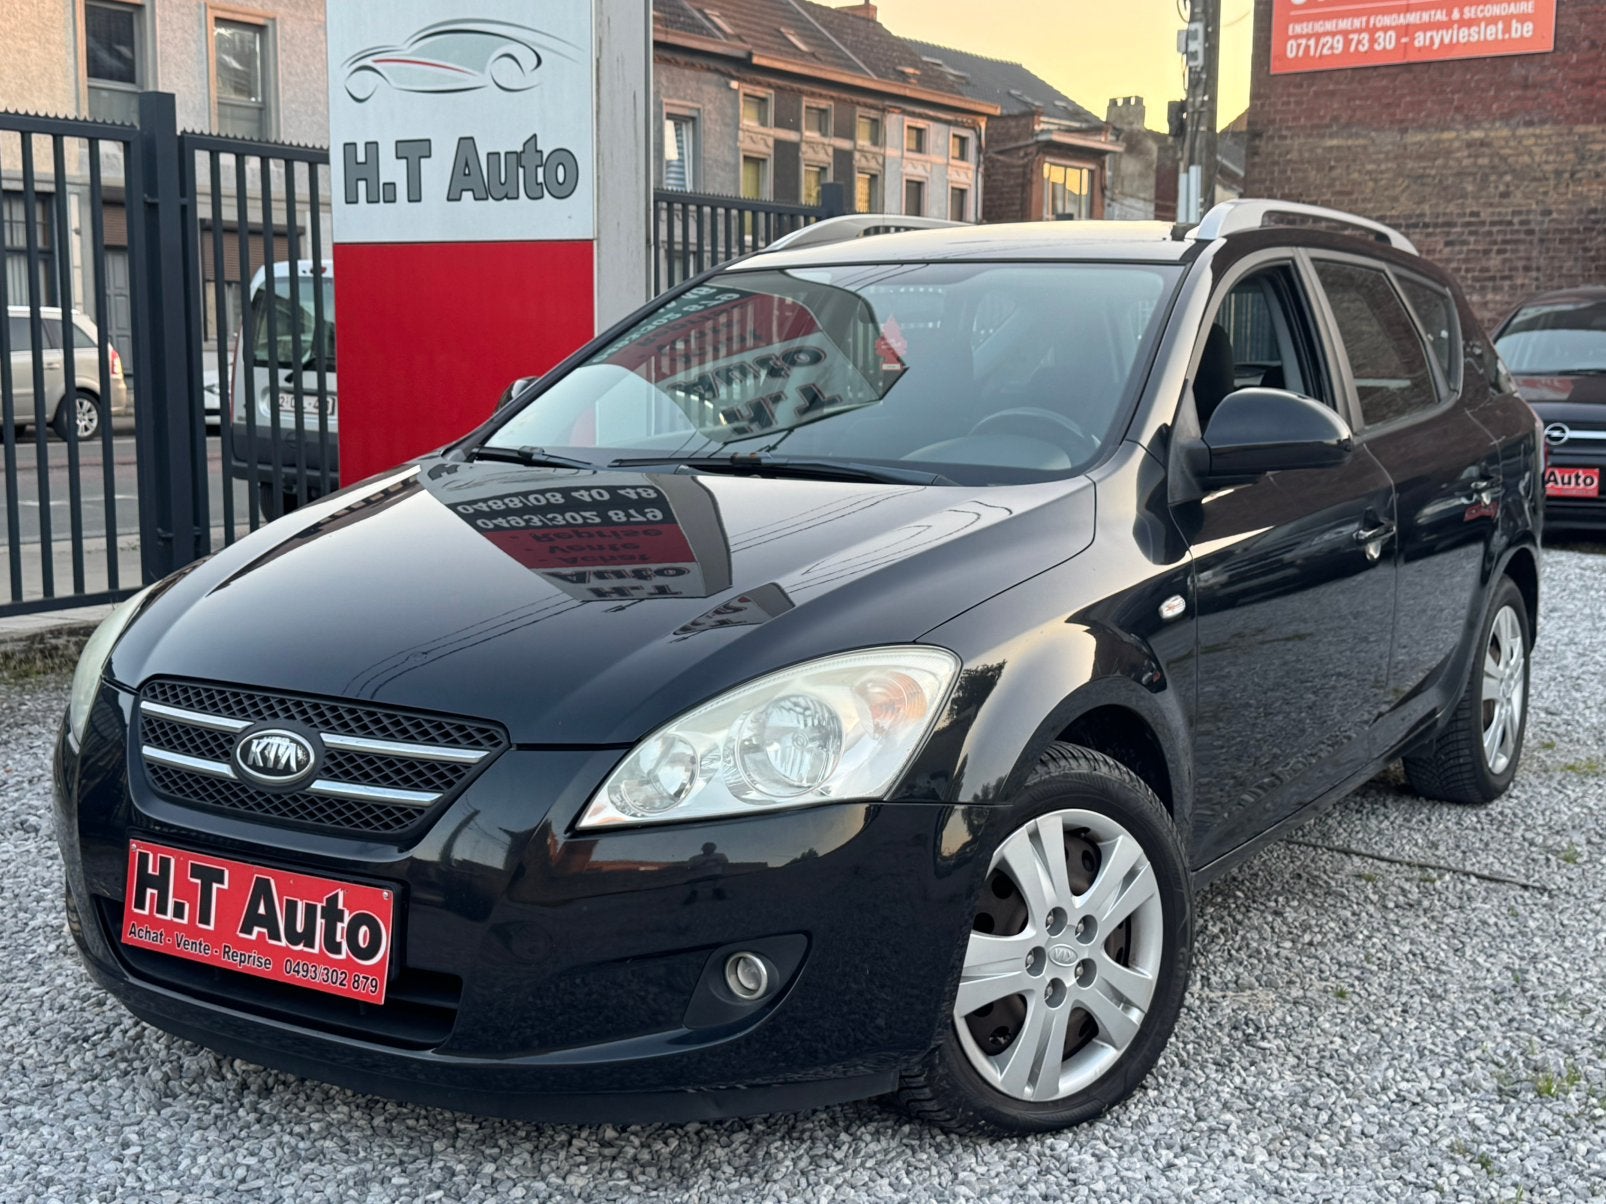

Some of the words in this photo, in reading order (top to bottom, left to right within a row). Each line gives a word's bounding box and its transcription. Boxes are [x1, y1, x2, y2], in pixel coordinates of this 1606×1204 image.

[1288, 16, 1368, 36] ENSEIGNEMENT
[1369, 9, 1448, 29] FONDAMENTAL
[1451, 7, 1460, 21] &
[1463, 0, 1535, 20] SECONDAIRE
[1286, 34, 1344, 59] 071/29
[1348, 32, 1370, 53] 73
[1374, 30, 1396, 51] 30
[1413, 19, 1535, 50] aryvieslet.be
[343, 138, 431, 205] H.T
[446, 133, 579, 202] Auto
[1546, 469, 1597, 488] Auto
[247, 737, 298, 773] KIA
[131, 847, 229, 930] H.T
[236, 874, 387, 965] Auto
[128, 922, 165, 945] Achat
[175, 932, 211, 956] Vente
[222, 944, 273, 970] Reprise
[284, 958, 347, 988] 0493/302
[352, 973, 379, 995] 879
